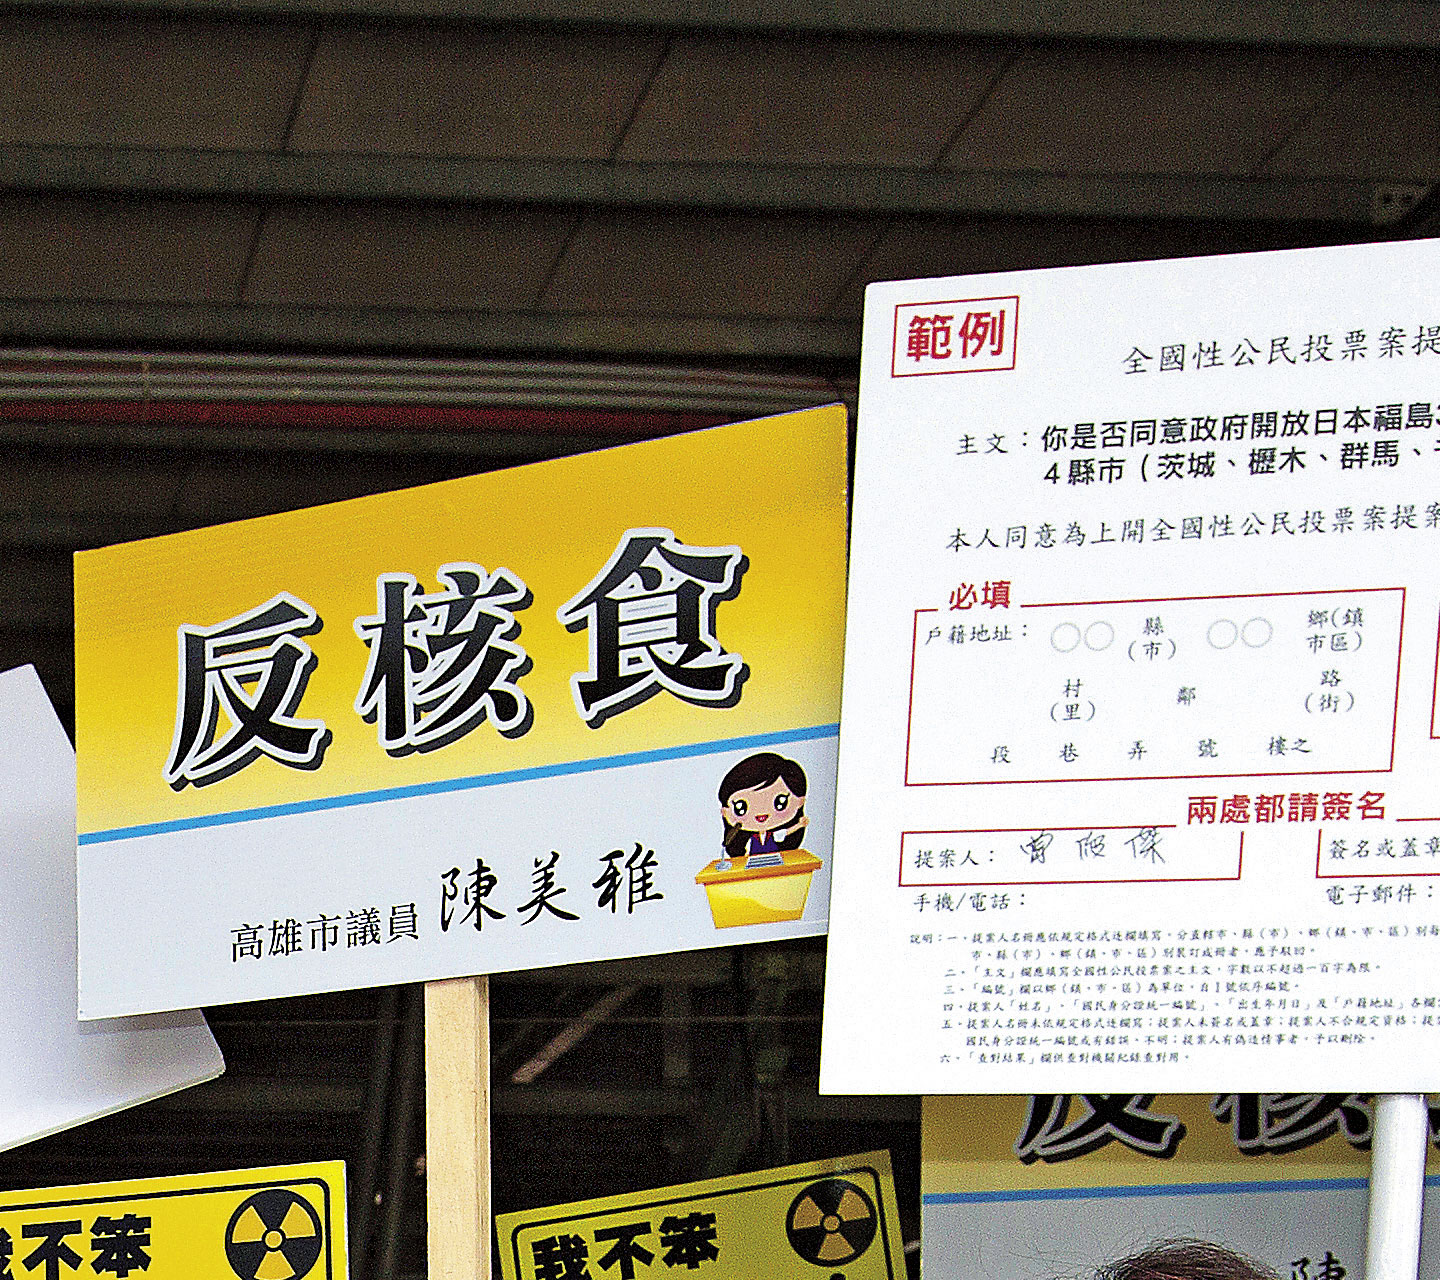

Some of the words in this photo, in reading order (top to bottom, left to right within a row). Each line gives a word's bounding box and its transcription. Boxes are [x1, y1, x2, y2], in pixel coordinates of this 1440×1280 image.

[906, 308, 1006, 363] 範例
[163, 526, 751, 791] 反核食
[230, 907, 421, 962] 高雄市議員
[440, 842, 666, 931] 陳美雅
